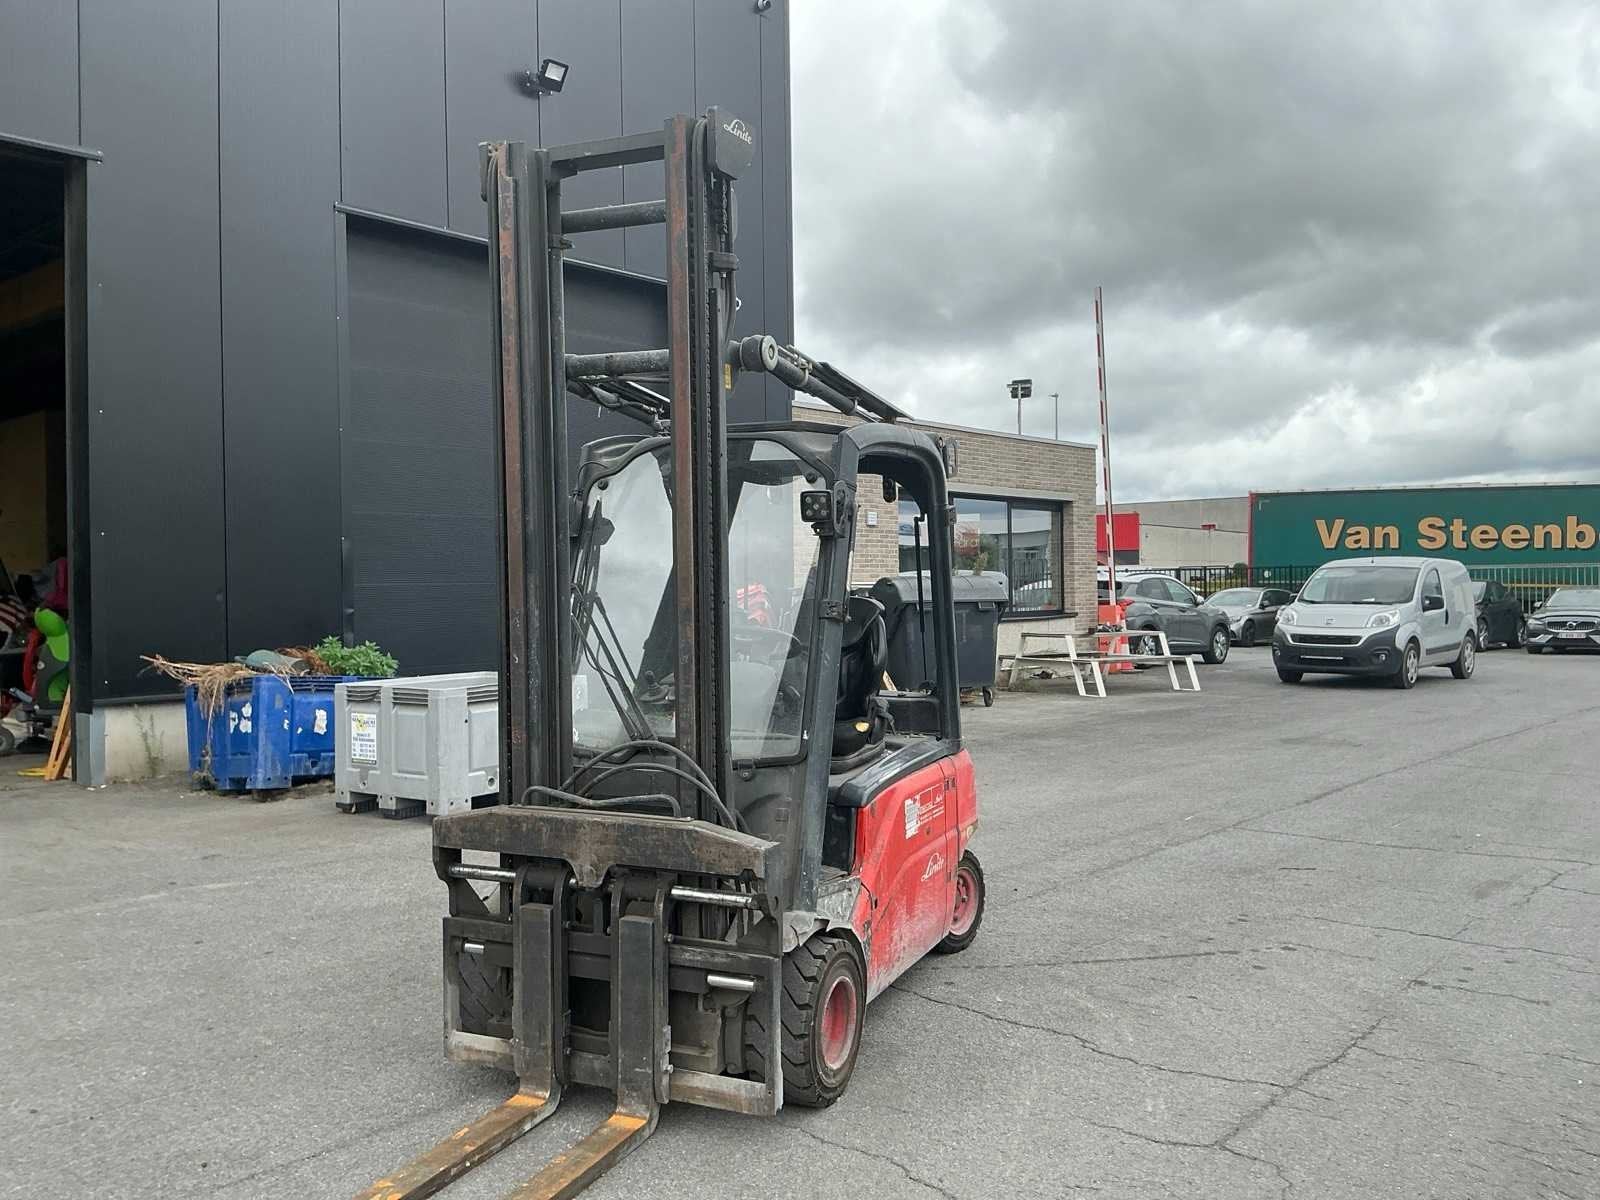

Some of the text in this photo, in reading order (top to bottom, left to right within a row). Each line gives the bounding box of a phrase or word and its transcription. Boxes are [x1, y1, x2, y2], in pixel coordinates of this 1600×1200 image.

[723, 118, 752, 145] Linde
[1315, 515, 1600, 549] Van Steenb
[921, 852, 945, 882] Linde
